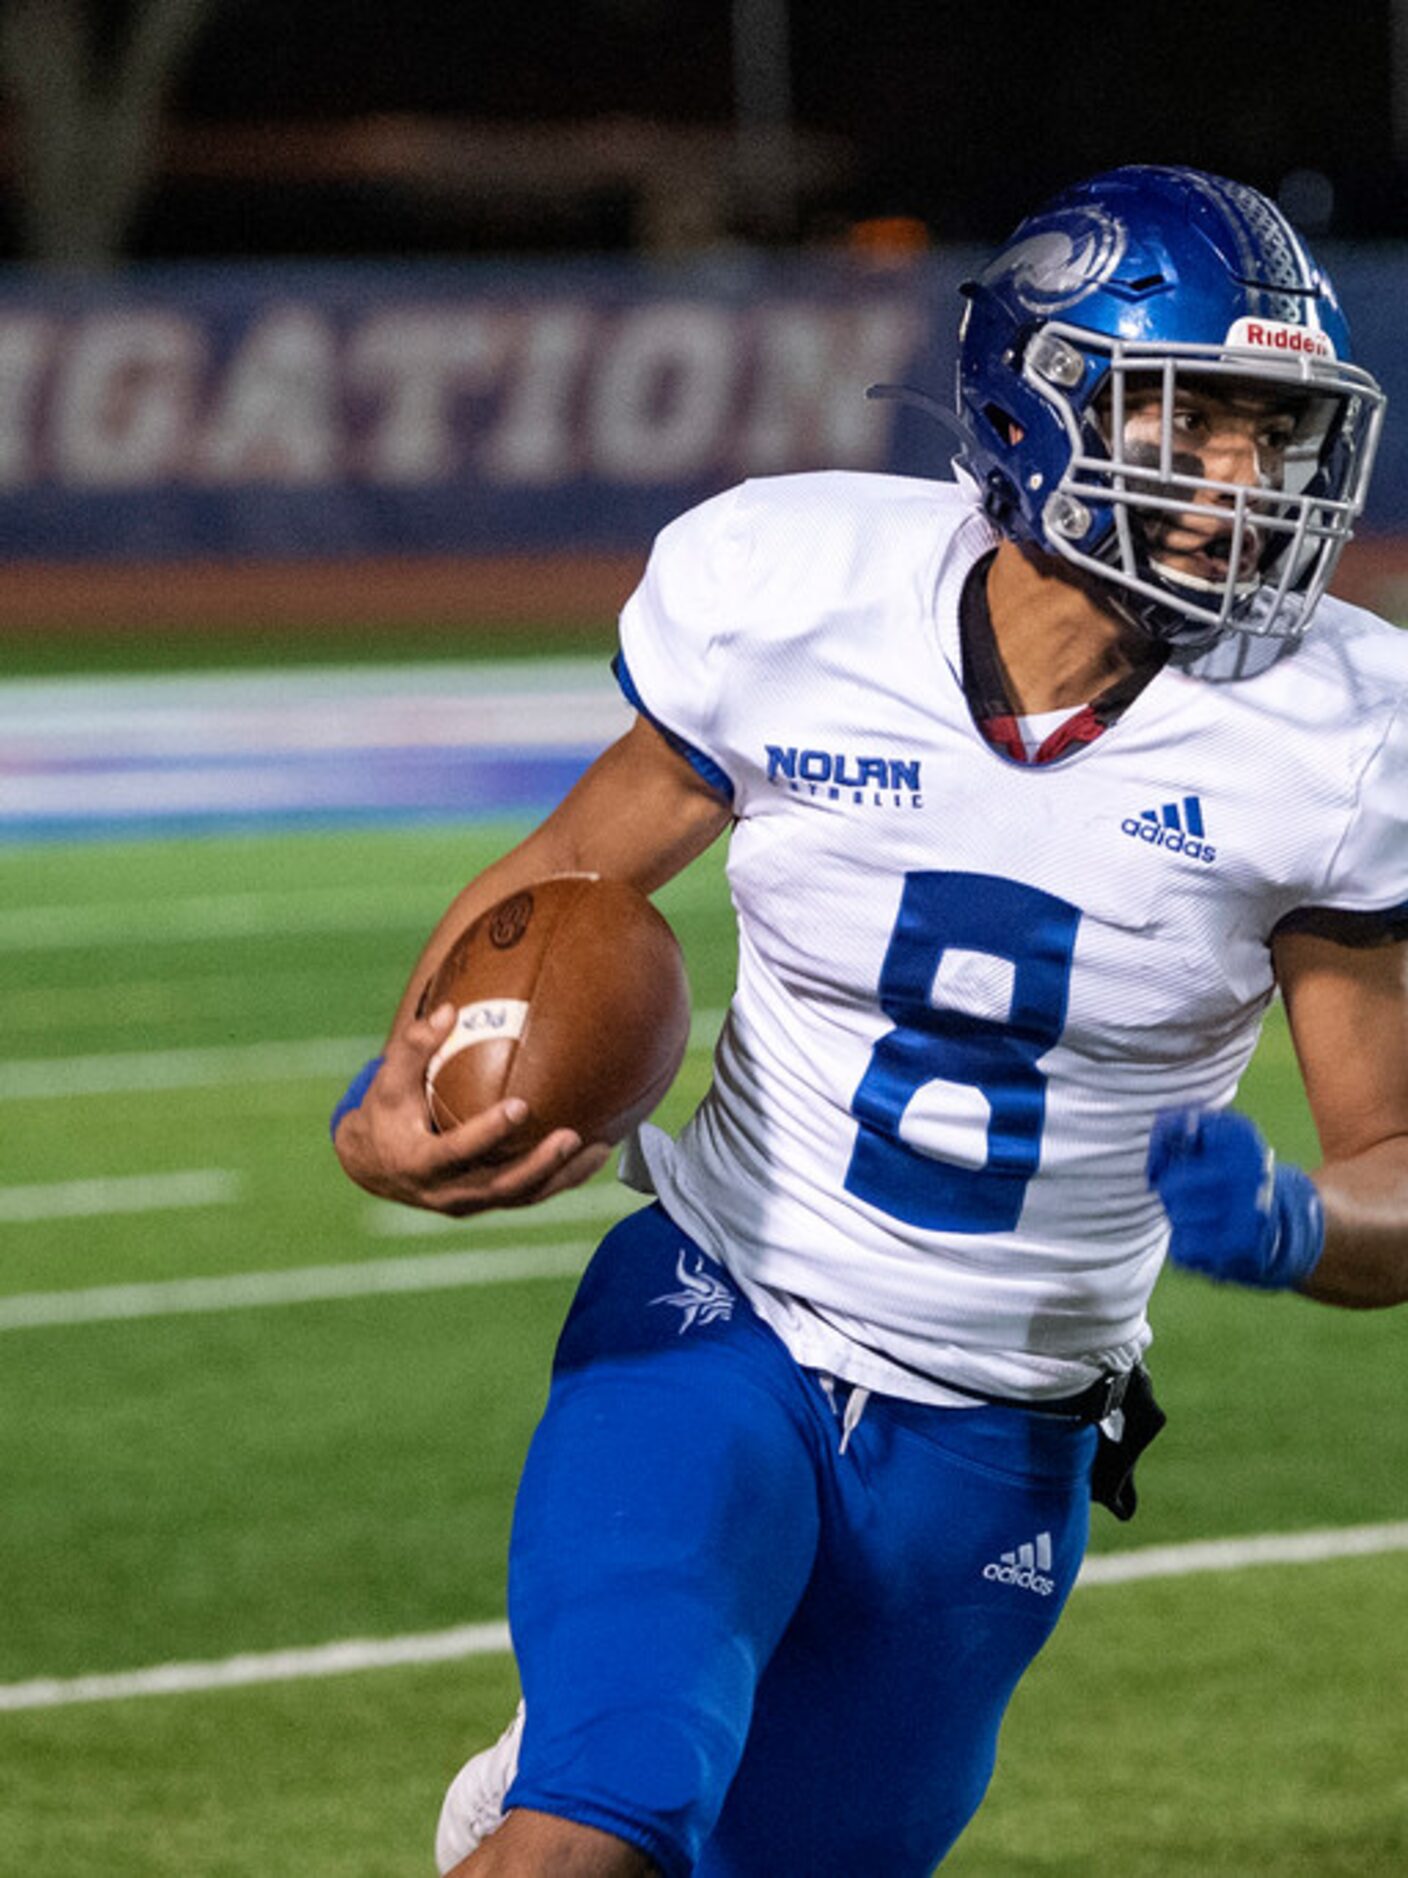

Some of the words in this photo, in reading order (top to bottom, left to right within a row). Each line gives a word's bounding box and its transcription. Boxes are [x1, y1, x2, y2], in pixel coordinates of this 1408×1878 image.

[765, 744, 921, 791] NOLAN
[1121, 818, 1216, 863] adidas
[844, 870, 1083, 1233] 8
[982, 1563, 1055, 1596] adidas
